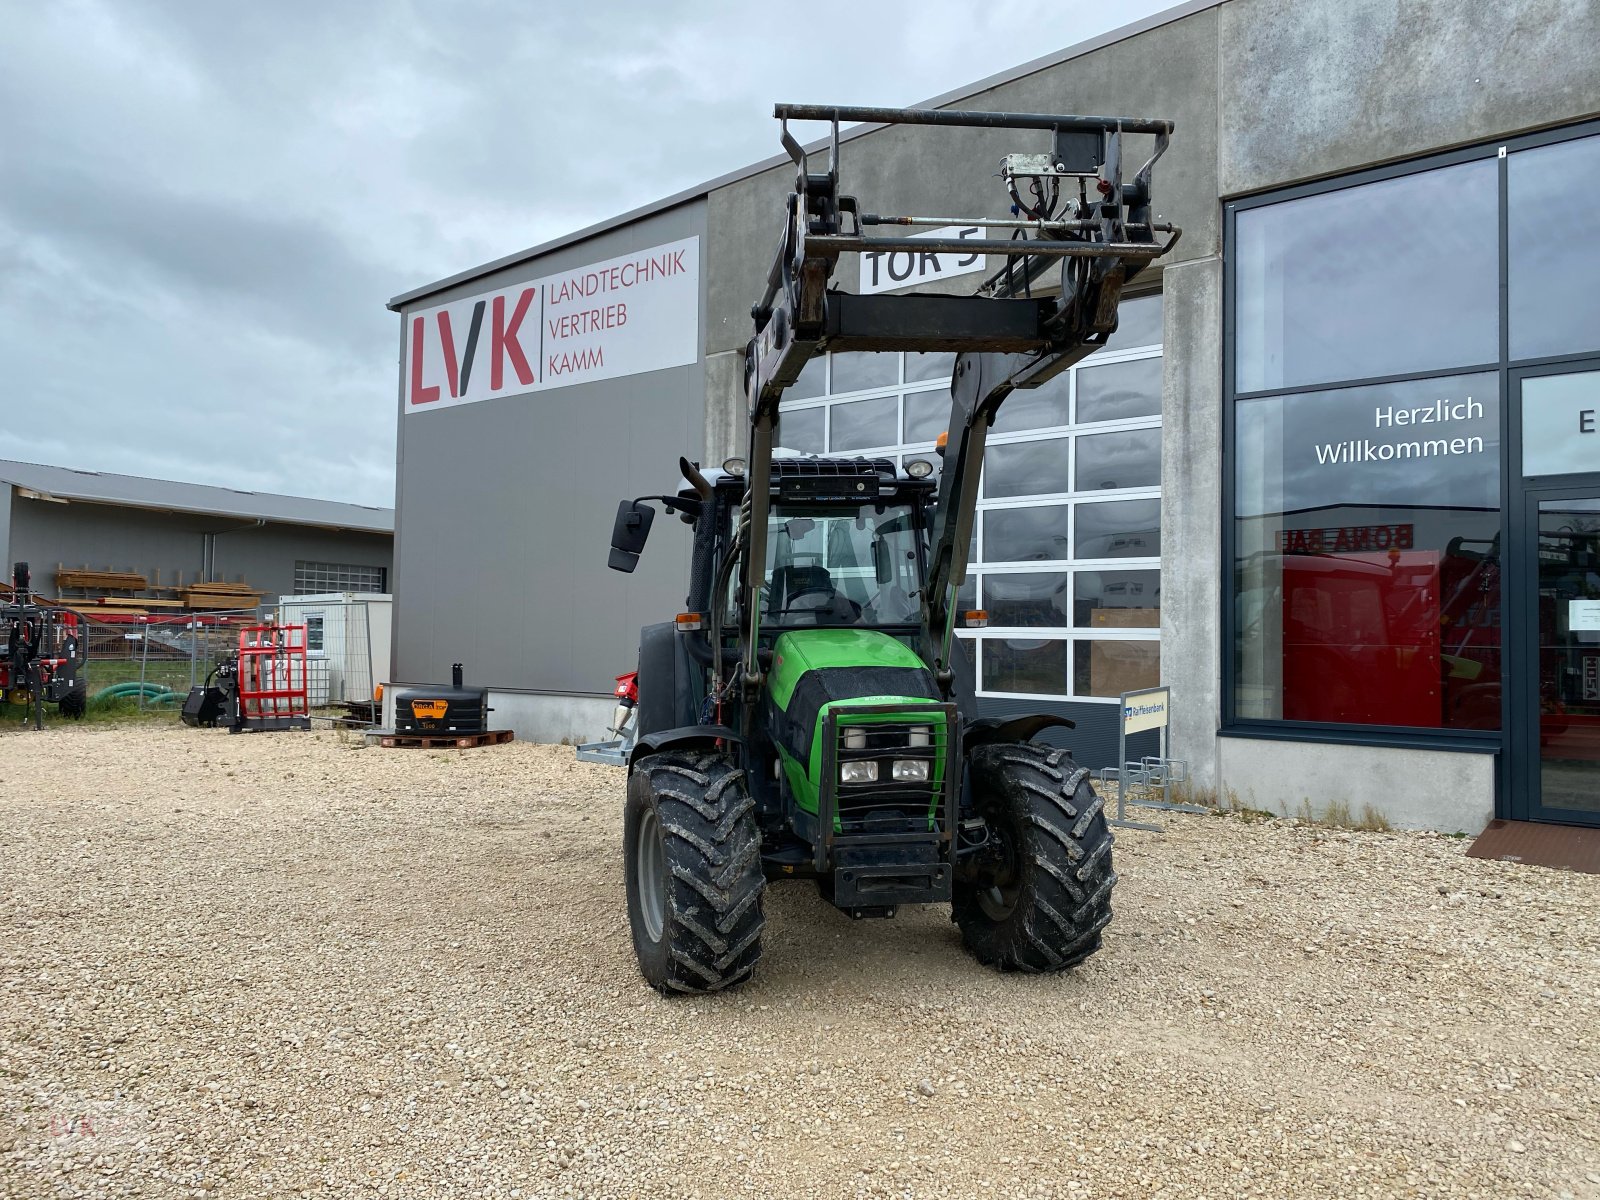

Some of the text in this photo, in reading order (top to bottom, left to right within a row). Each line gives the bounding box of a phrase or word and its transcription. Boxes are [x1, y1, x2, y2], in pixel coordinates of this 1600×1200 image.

[865, 227, 979, 286] TOR 5
[551, 249, 686, 305] LANDTECHNIK
[549, 303, 628, 340] VERTRIEB
[410, 287, 536, 405] LVK
[549, 345, 604, 377] KAMM
[1375, 396, 1484, 428] Herzlich
[1315, 435, 1483, 465] Willkommen
[1133, 702, 1164, 716] Raiffeisenbank
